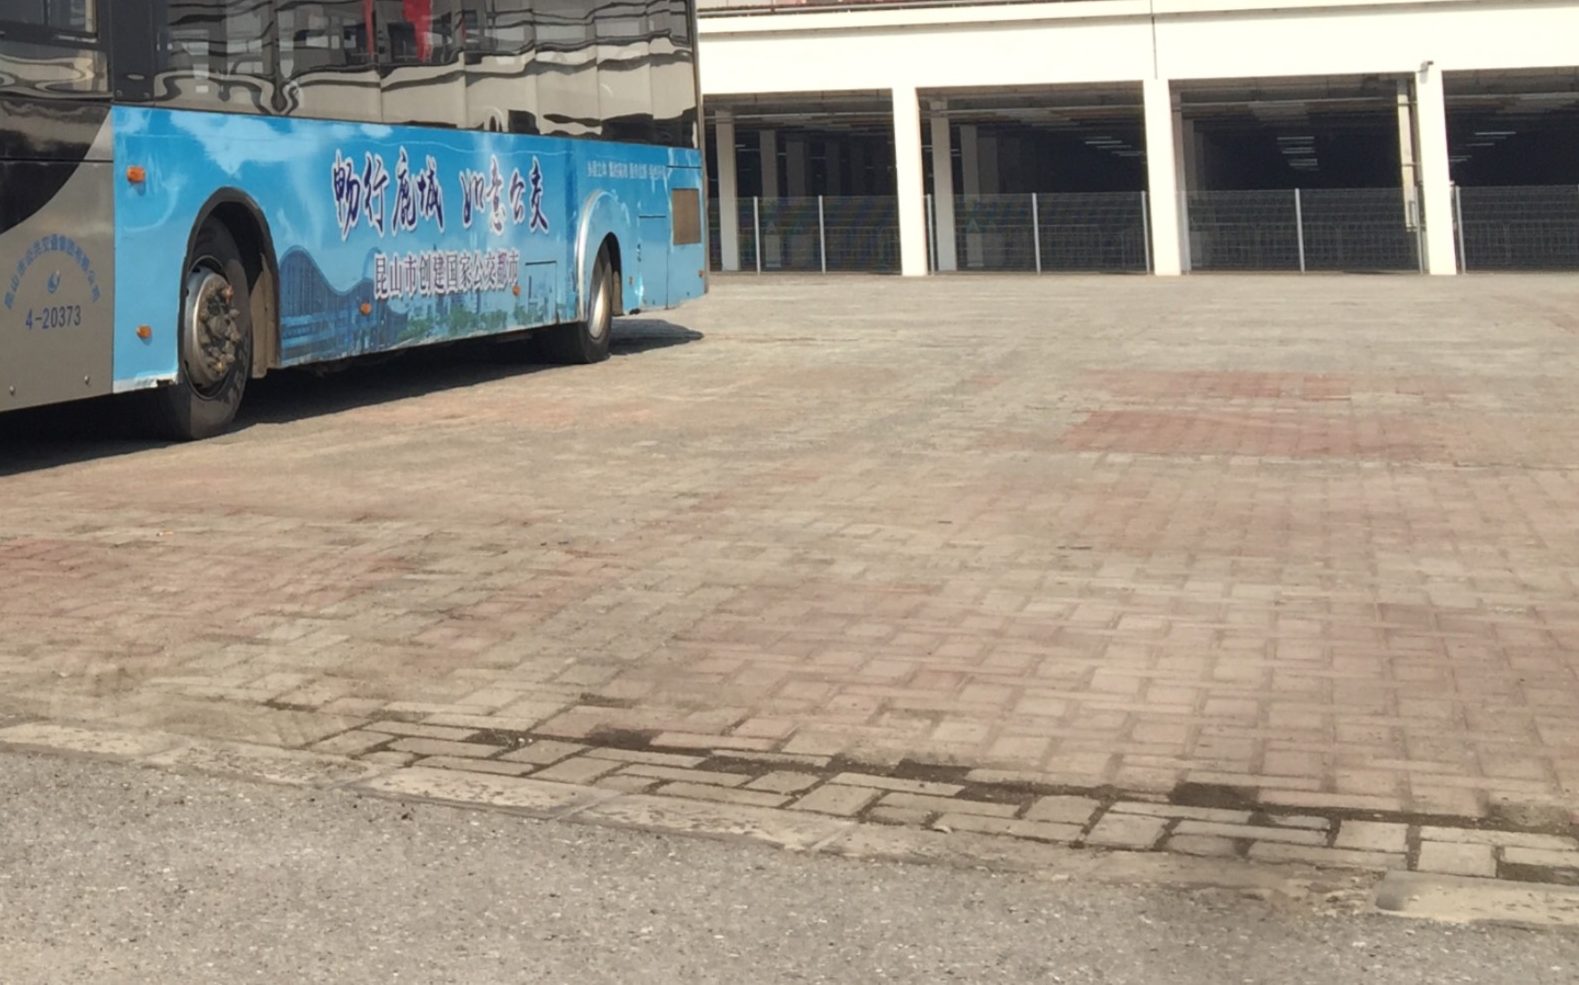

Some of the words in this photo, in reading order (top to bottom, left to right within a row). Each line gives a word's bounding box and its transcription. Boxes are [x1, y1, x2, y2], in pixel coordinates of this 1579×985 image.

[331, 145, 445, 242] 畅行鹿城
[458, 153, 550, 236] 如意公交
[373, 249, 520, 301] 昆山市创建国家公交都市
[25, 305, 82, 330] 4-20373
